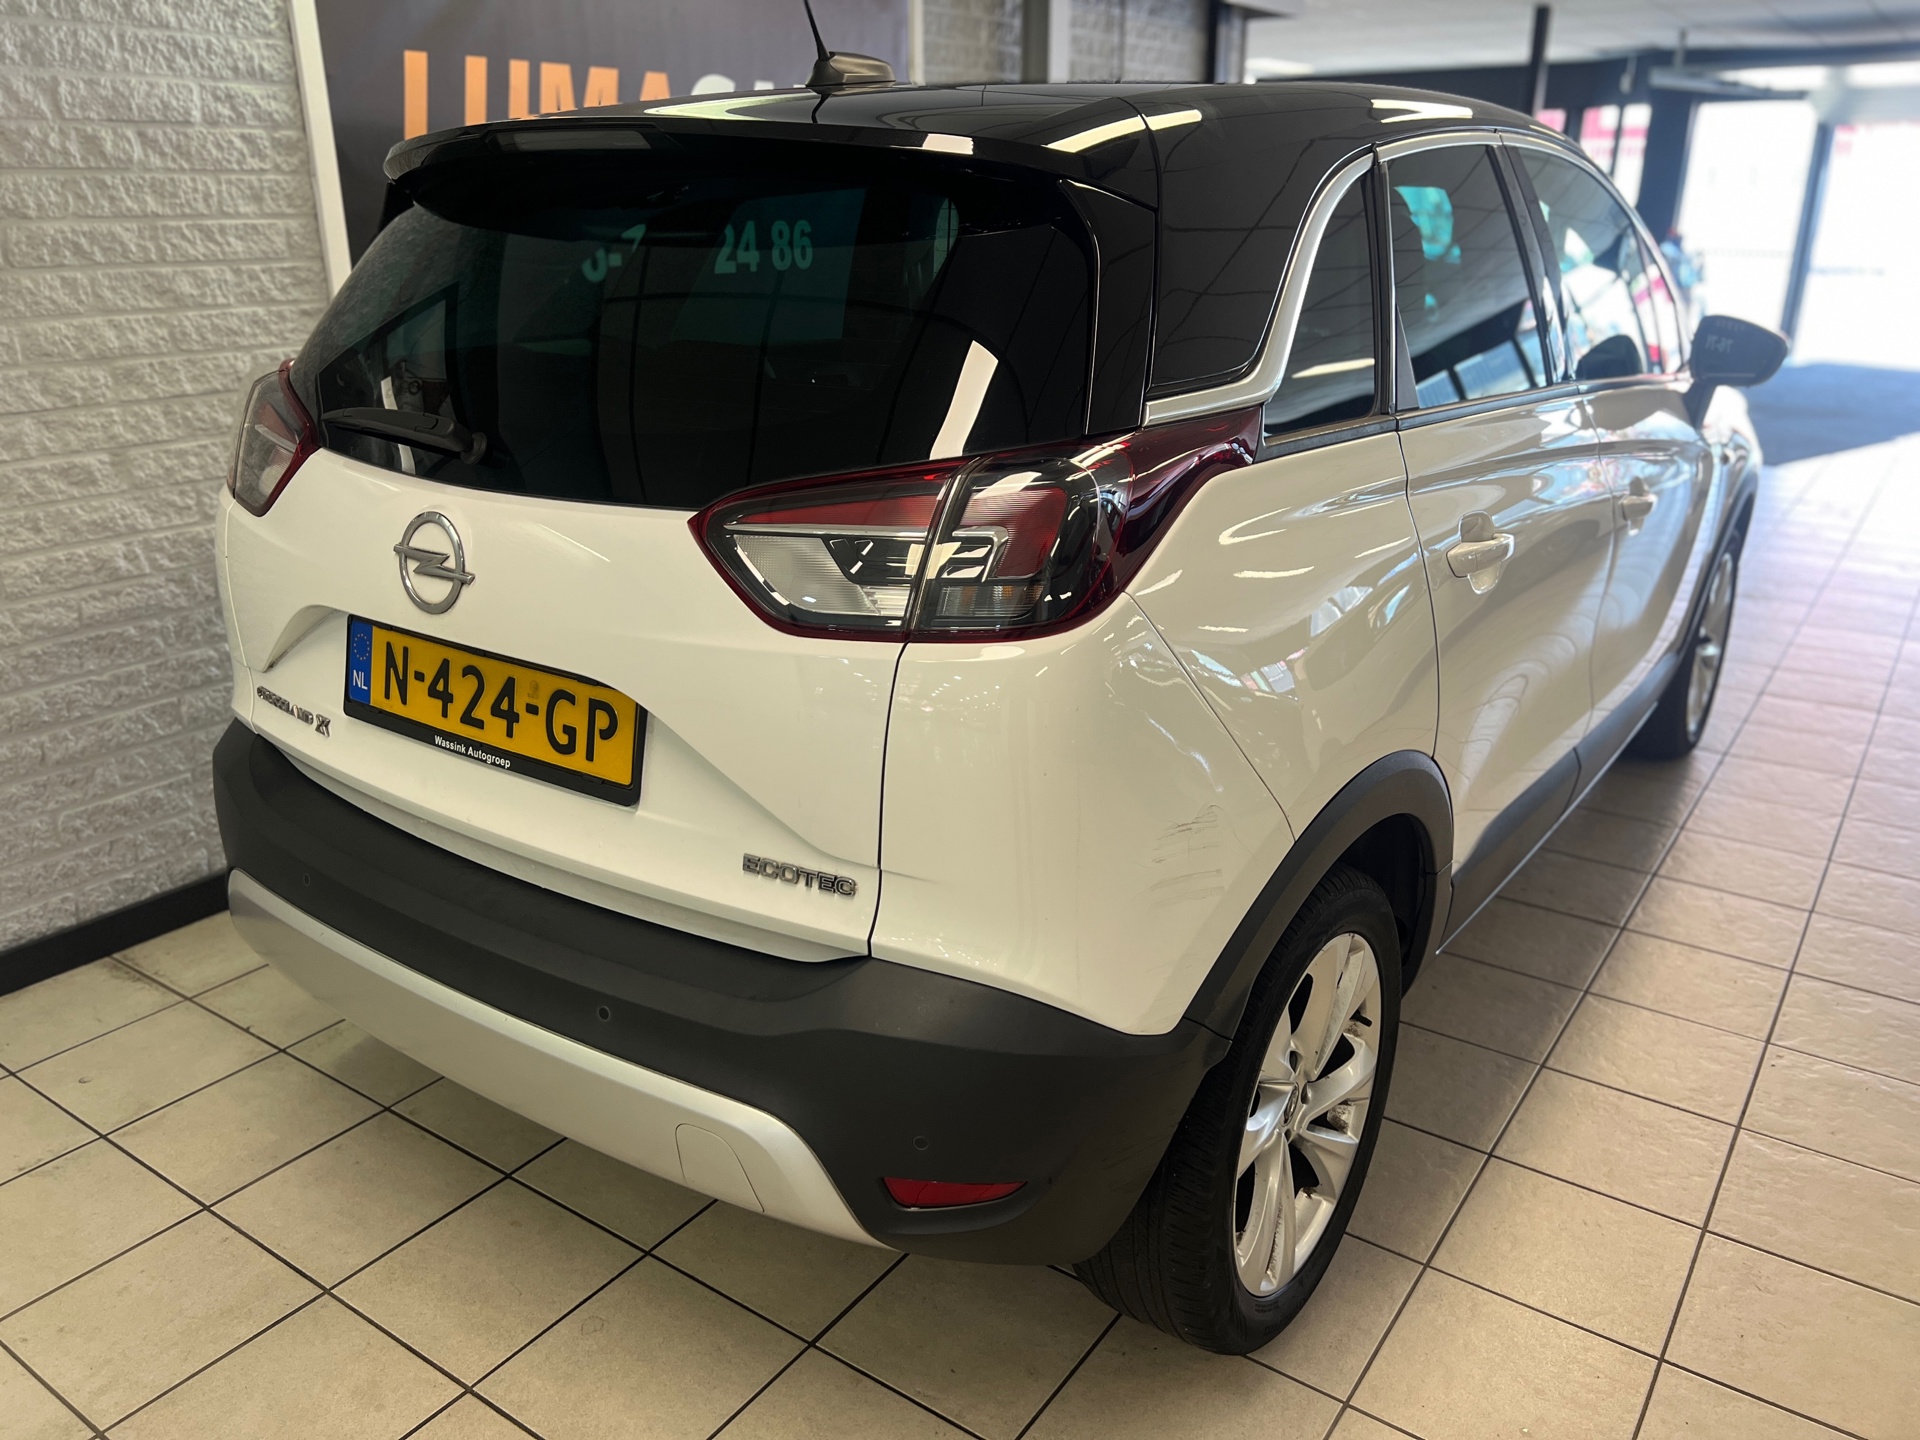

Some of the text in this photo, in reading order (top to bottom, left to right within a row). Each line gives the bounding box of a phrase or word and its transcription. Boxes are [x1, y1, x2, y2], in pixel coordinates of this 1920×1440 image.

[714, 220, 760, 274] 24
[771, 219, 813, 271] 86
[352, 669, 369, 690] NL
[384, 640, 618, 763] N-424-GP
[434, 734, 511, 769] Wassink Autogroep
[742, 853, 857, 897] ECOTEC
